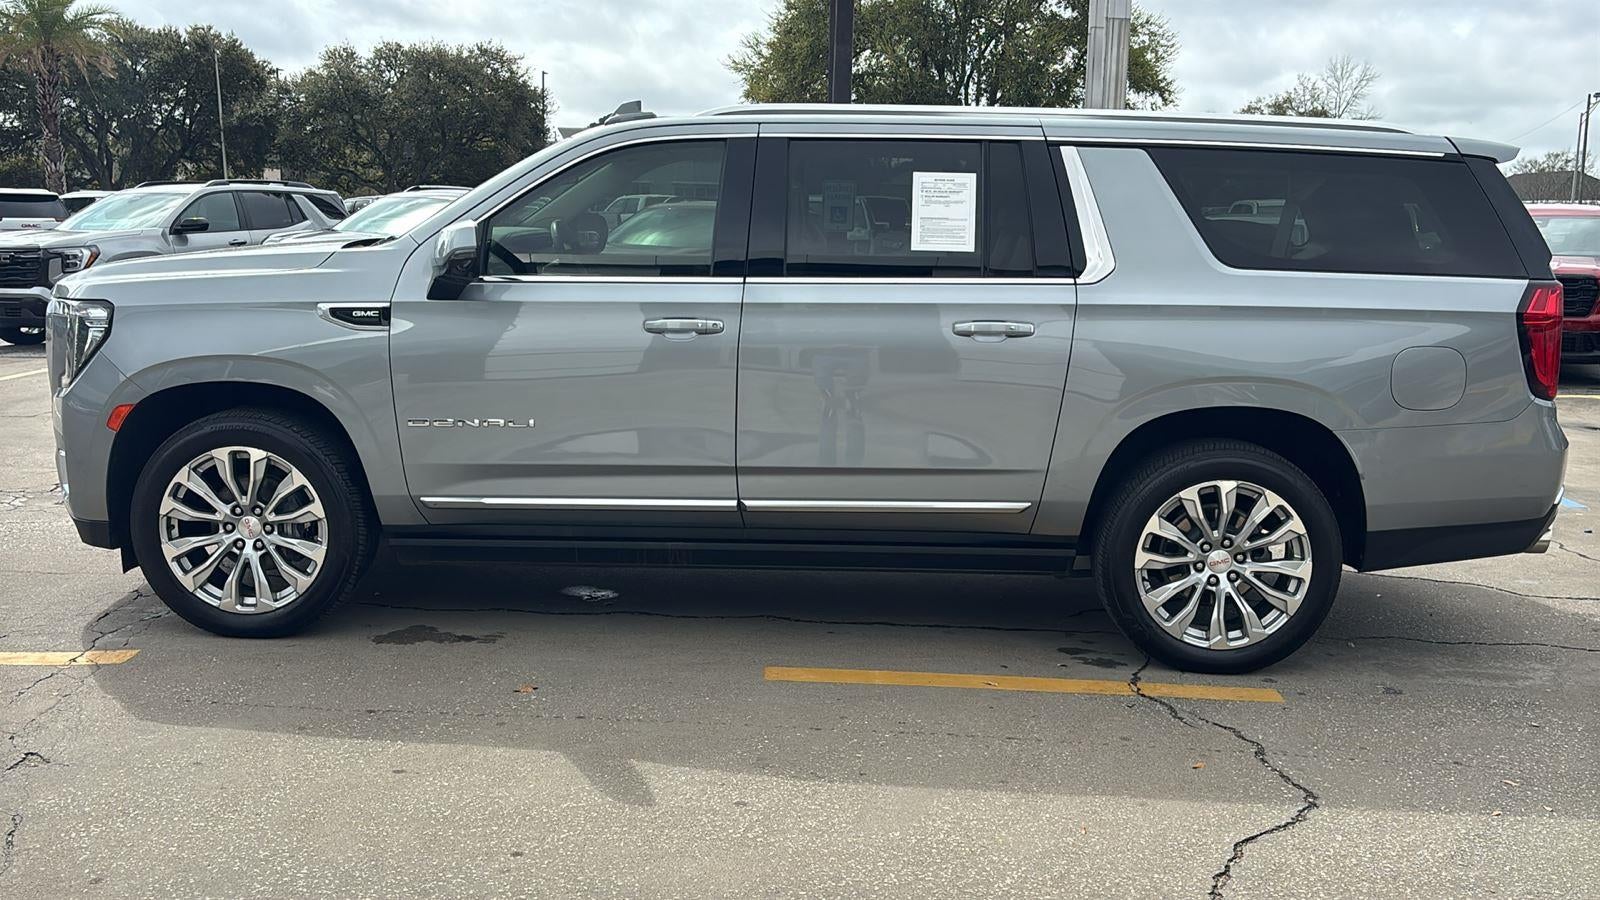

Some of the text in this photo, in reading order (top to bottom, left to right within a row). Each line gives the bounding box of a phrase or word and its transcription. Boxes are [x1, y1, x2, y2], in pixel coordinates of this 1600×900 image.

[352, 310, 380, 318] GMC
[407, 418, 535, 428] DENALI
[243, 517, 255, 538] GMC
[1209, 557, 1230, 567] GMC
